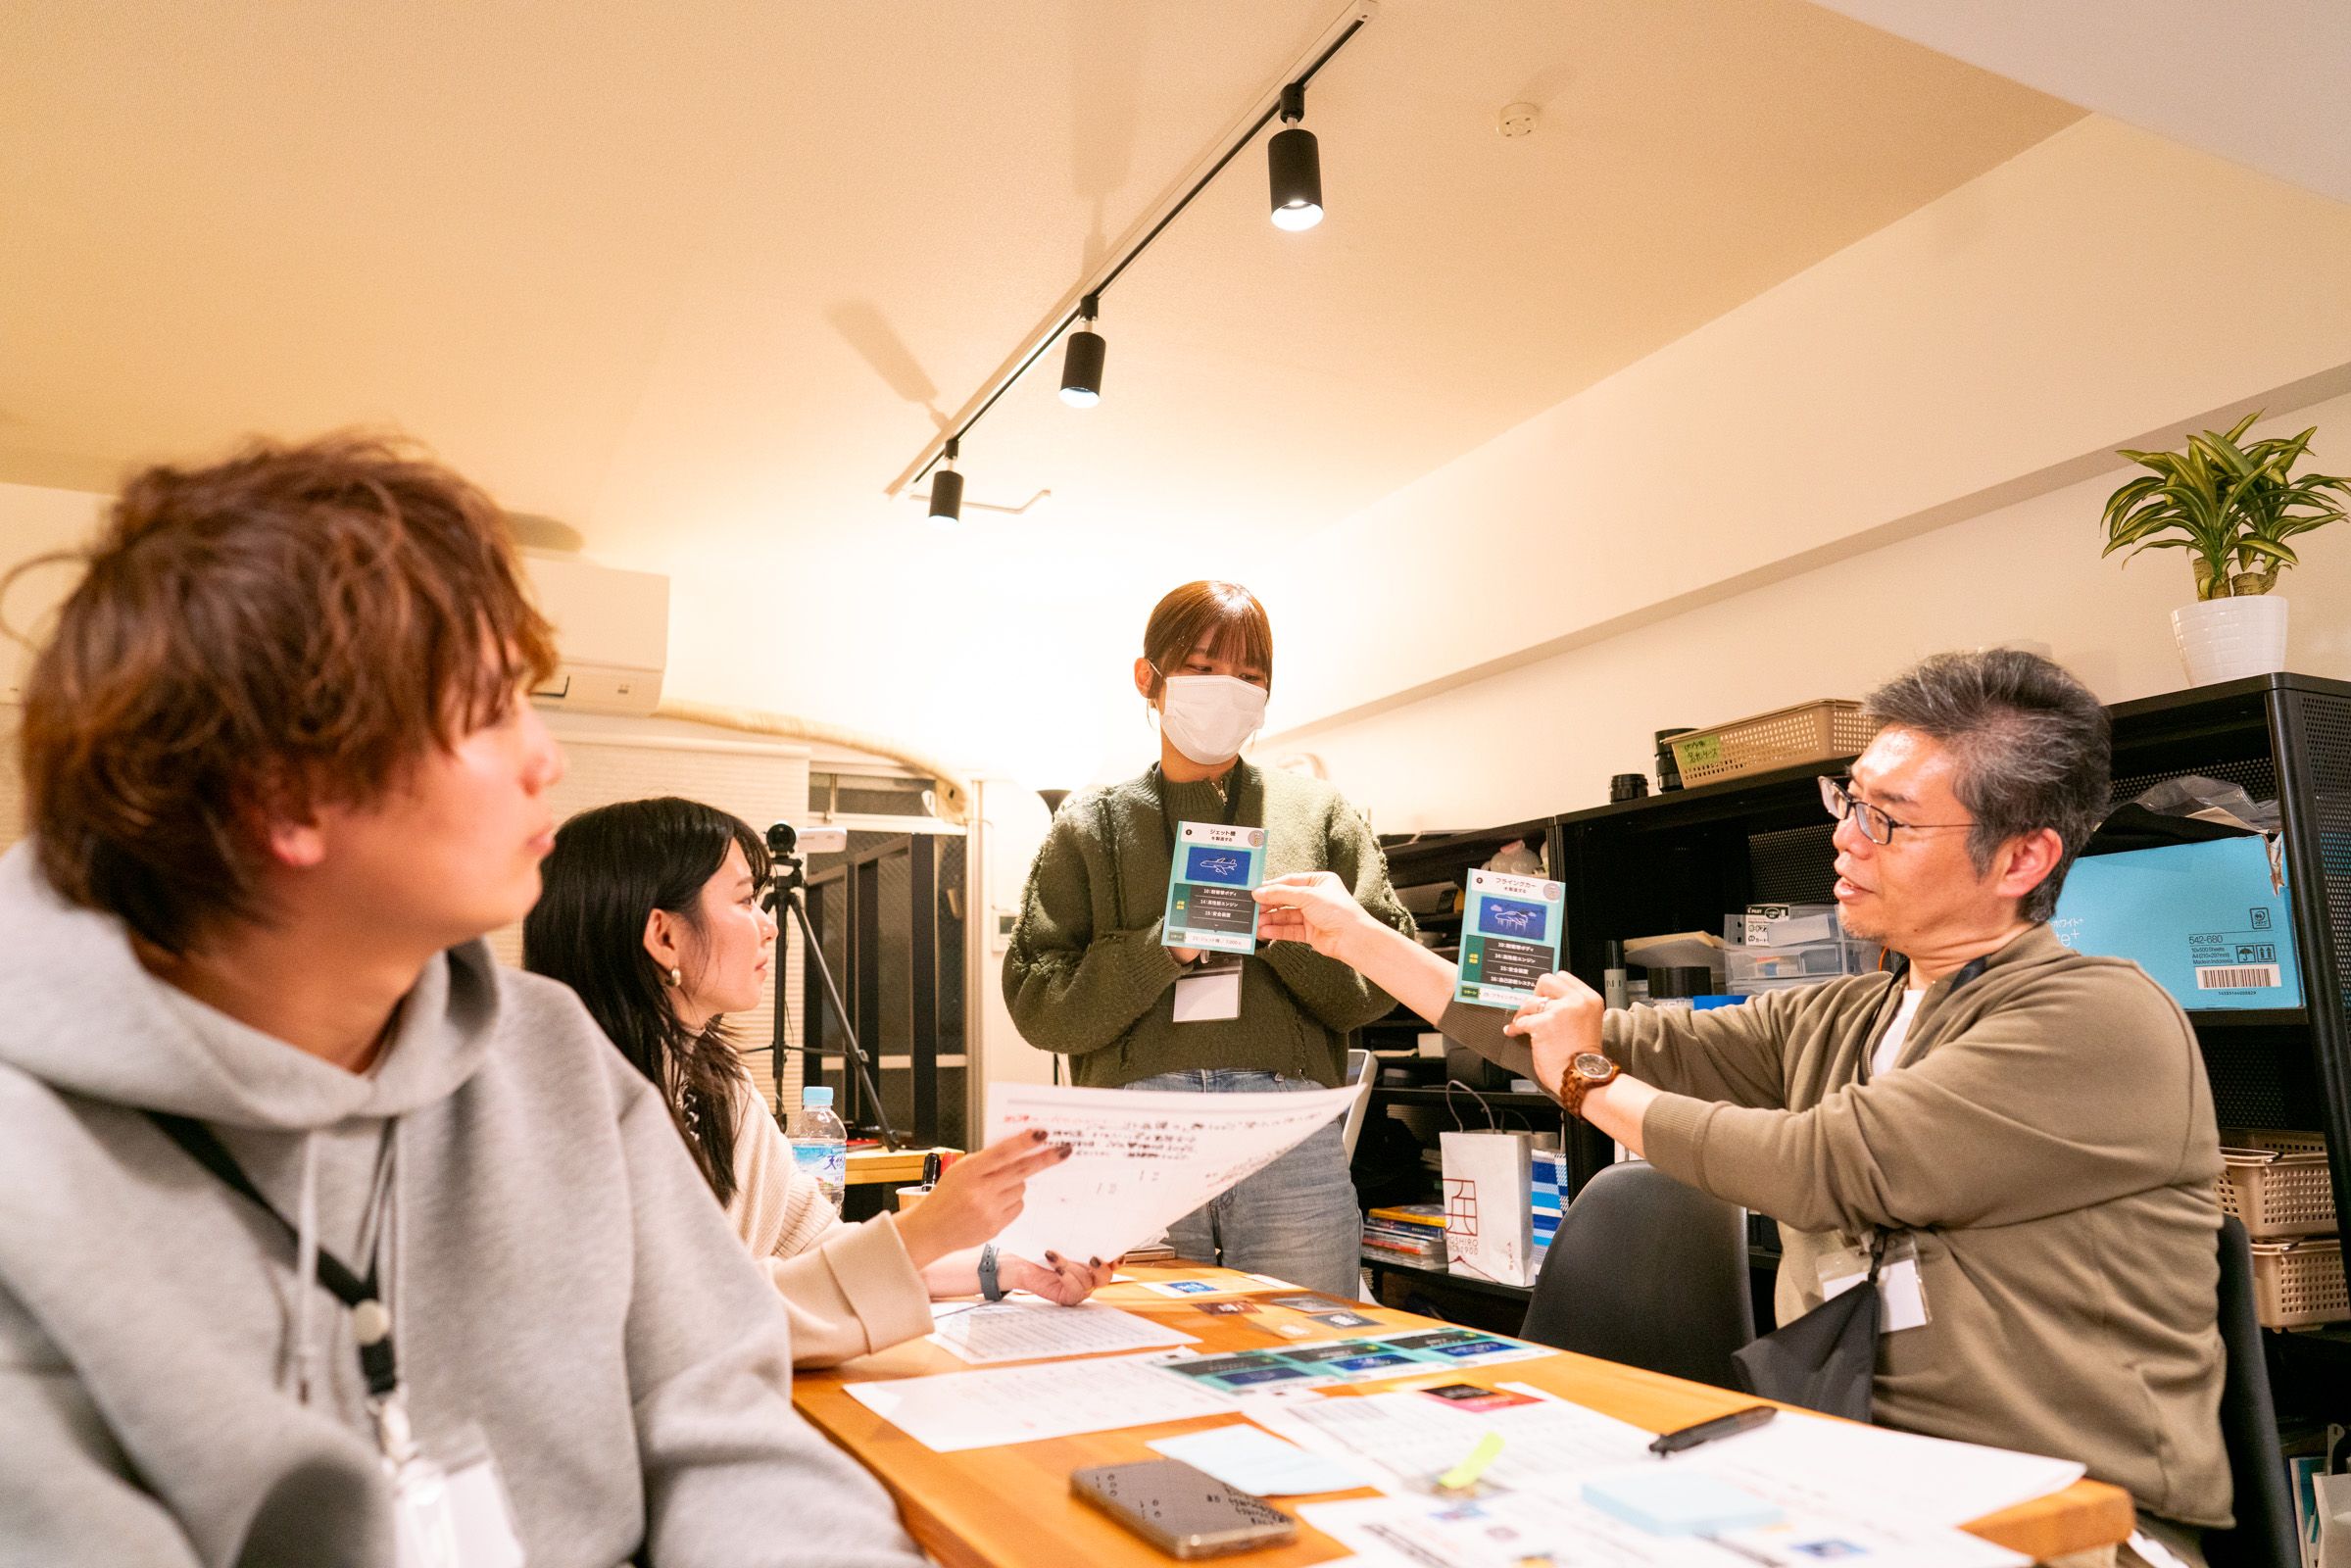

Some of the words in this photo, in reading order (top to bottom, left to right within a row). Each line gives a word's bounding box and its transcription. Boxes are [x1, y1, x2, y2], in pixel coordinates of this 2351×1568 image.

[1495, 877, 1537, 888] フライングカー
[2188, 934, 2223, 944] 542-680
